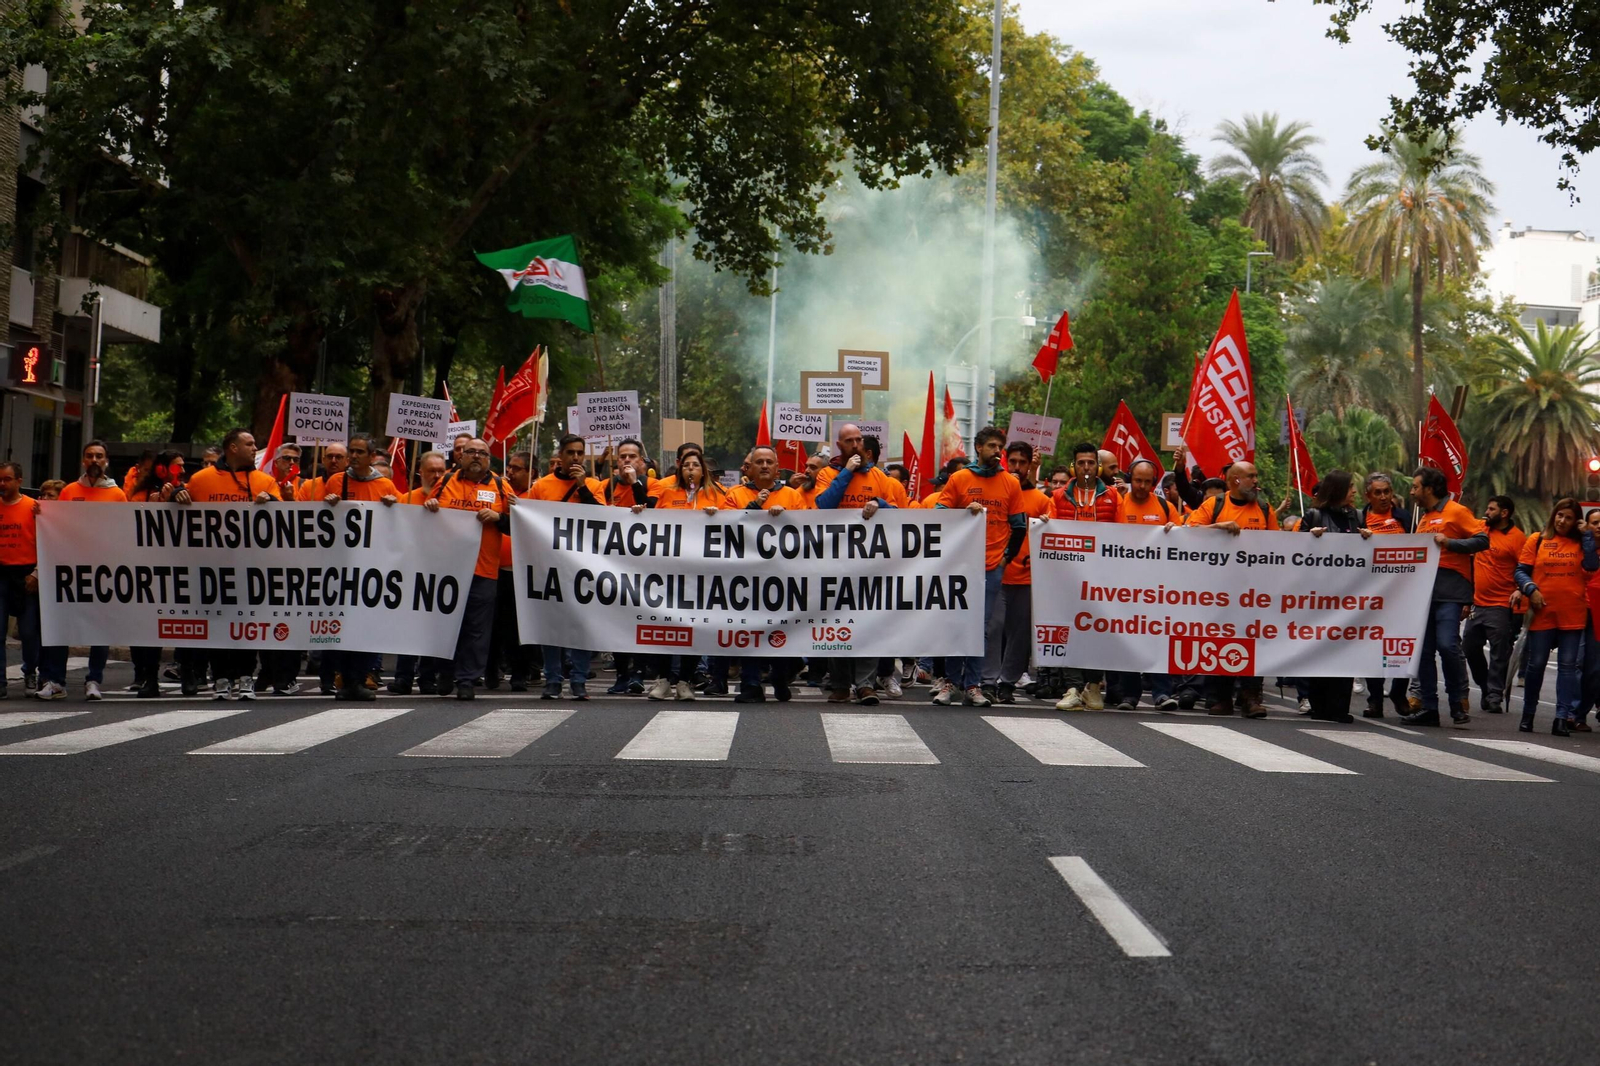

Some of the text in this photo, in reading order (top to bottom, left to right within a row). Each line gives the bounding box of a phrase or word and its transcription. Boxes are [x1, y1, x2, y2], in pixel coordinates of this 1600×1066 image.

[304, 399, 344, 407] CONCILIACIÓN
[402, 400, 440, 411] EXPEDIENTES
[589, 396, 627, 404] EXPEDIENTES
[296, 406, 344, 418] NO ES UNA
[398, 408, 442, 420] DE PRESIÓN
[587, 406, 597, 414] DE
[598, 403, 630, 412] PRESIÓN
[418, 420, 434, 428] MÁS
[794, 414, 803, 422] ES
[295, 418, 342, 432] OPCIÓN
[448, 425, 470, 433] ERSIONES
[590, 422, 630, 432] OPRESIÓN!
[779, 424, 822, 435] OPCIÓN
[397, 426, 438, 438] OPRESIÓN!
[450, 498, 492, 509] HITACHI
[134, 508, 374, 548] INVERSIONES SI
[553, 517, 942, 560] HITACHI EN CONTRA DE
[1043, 535, 1083, 550] CCOO
[1039, 550, 1085, 562] industria
[1101, 544, 1366, 568] Hitachi Energy Spain Córdoba
[1375, 550, 1414, 562] CCOO
[1371, 564, 1416, 574] industria
[55, 565, 459, 615] RECORTE DE DERECHOS NO
[527, 565, 968, 612] LA CONCILIACION FAMILIAR
[1080, 581, 1384, 614] Inversiones de primera
[157, 608, 222, 616] COMITE
[636, 614, 709, 624] COMITE
[161, 622, 206, 637] CCOO
[230, 622, 270, 641] UGT
[310, 619, 342, 635] USO
[1074, 612, 1384, 640] Condiciones de tercera
[310, 635, 340, 644] industria
[639, 628, 690, 644] CCOO
[718, 630, 764, 648] UGT
[812, 626, 852, 642] USO
[812, 642, 852, 650] industria
[1043, 644, 1066, 657] FIC
[1173, 640, 1250, 674] USO
